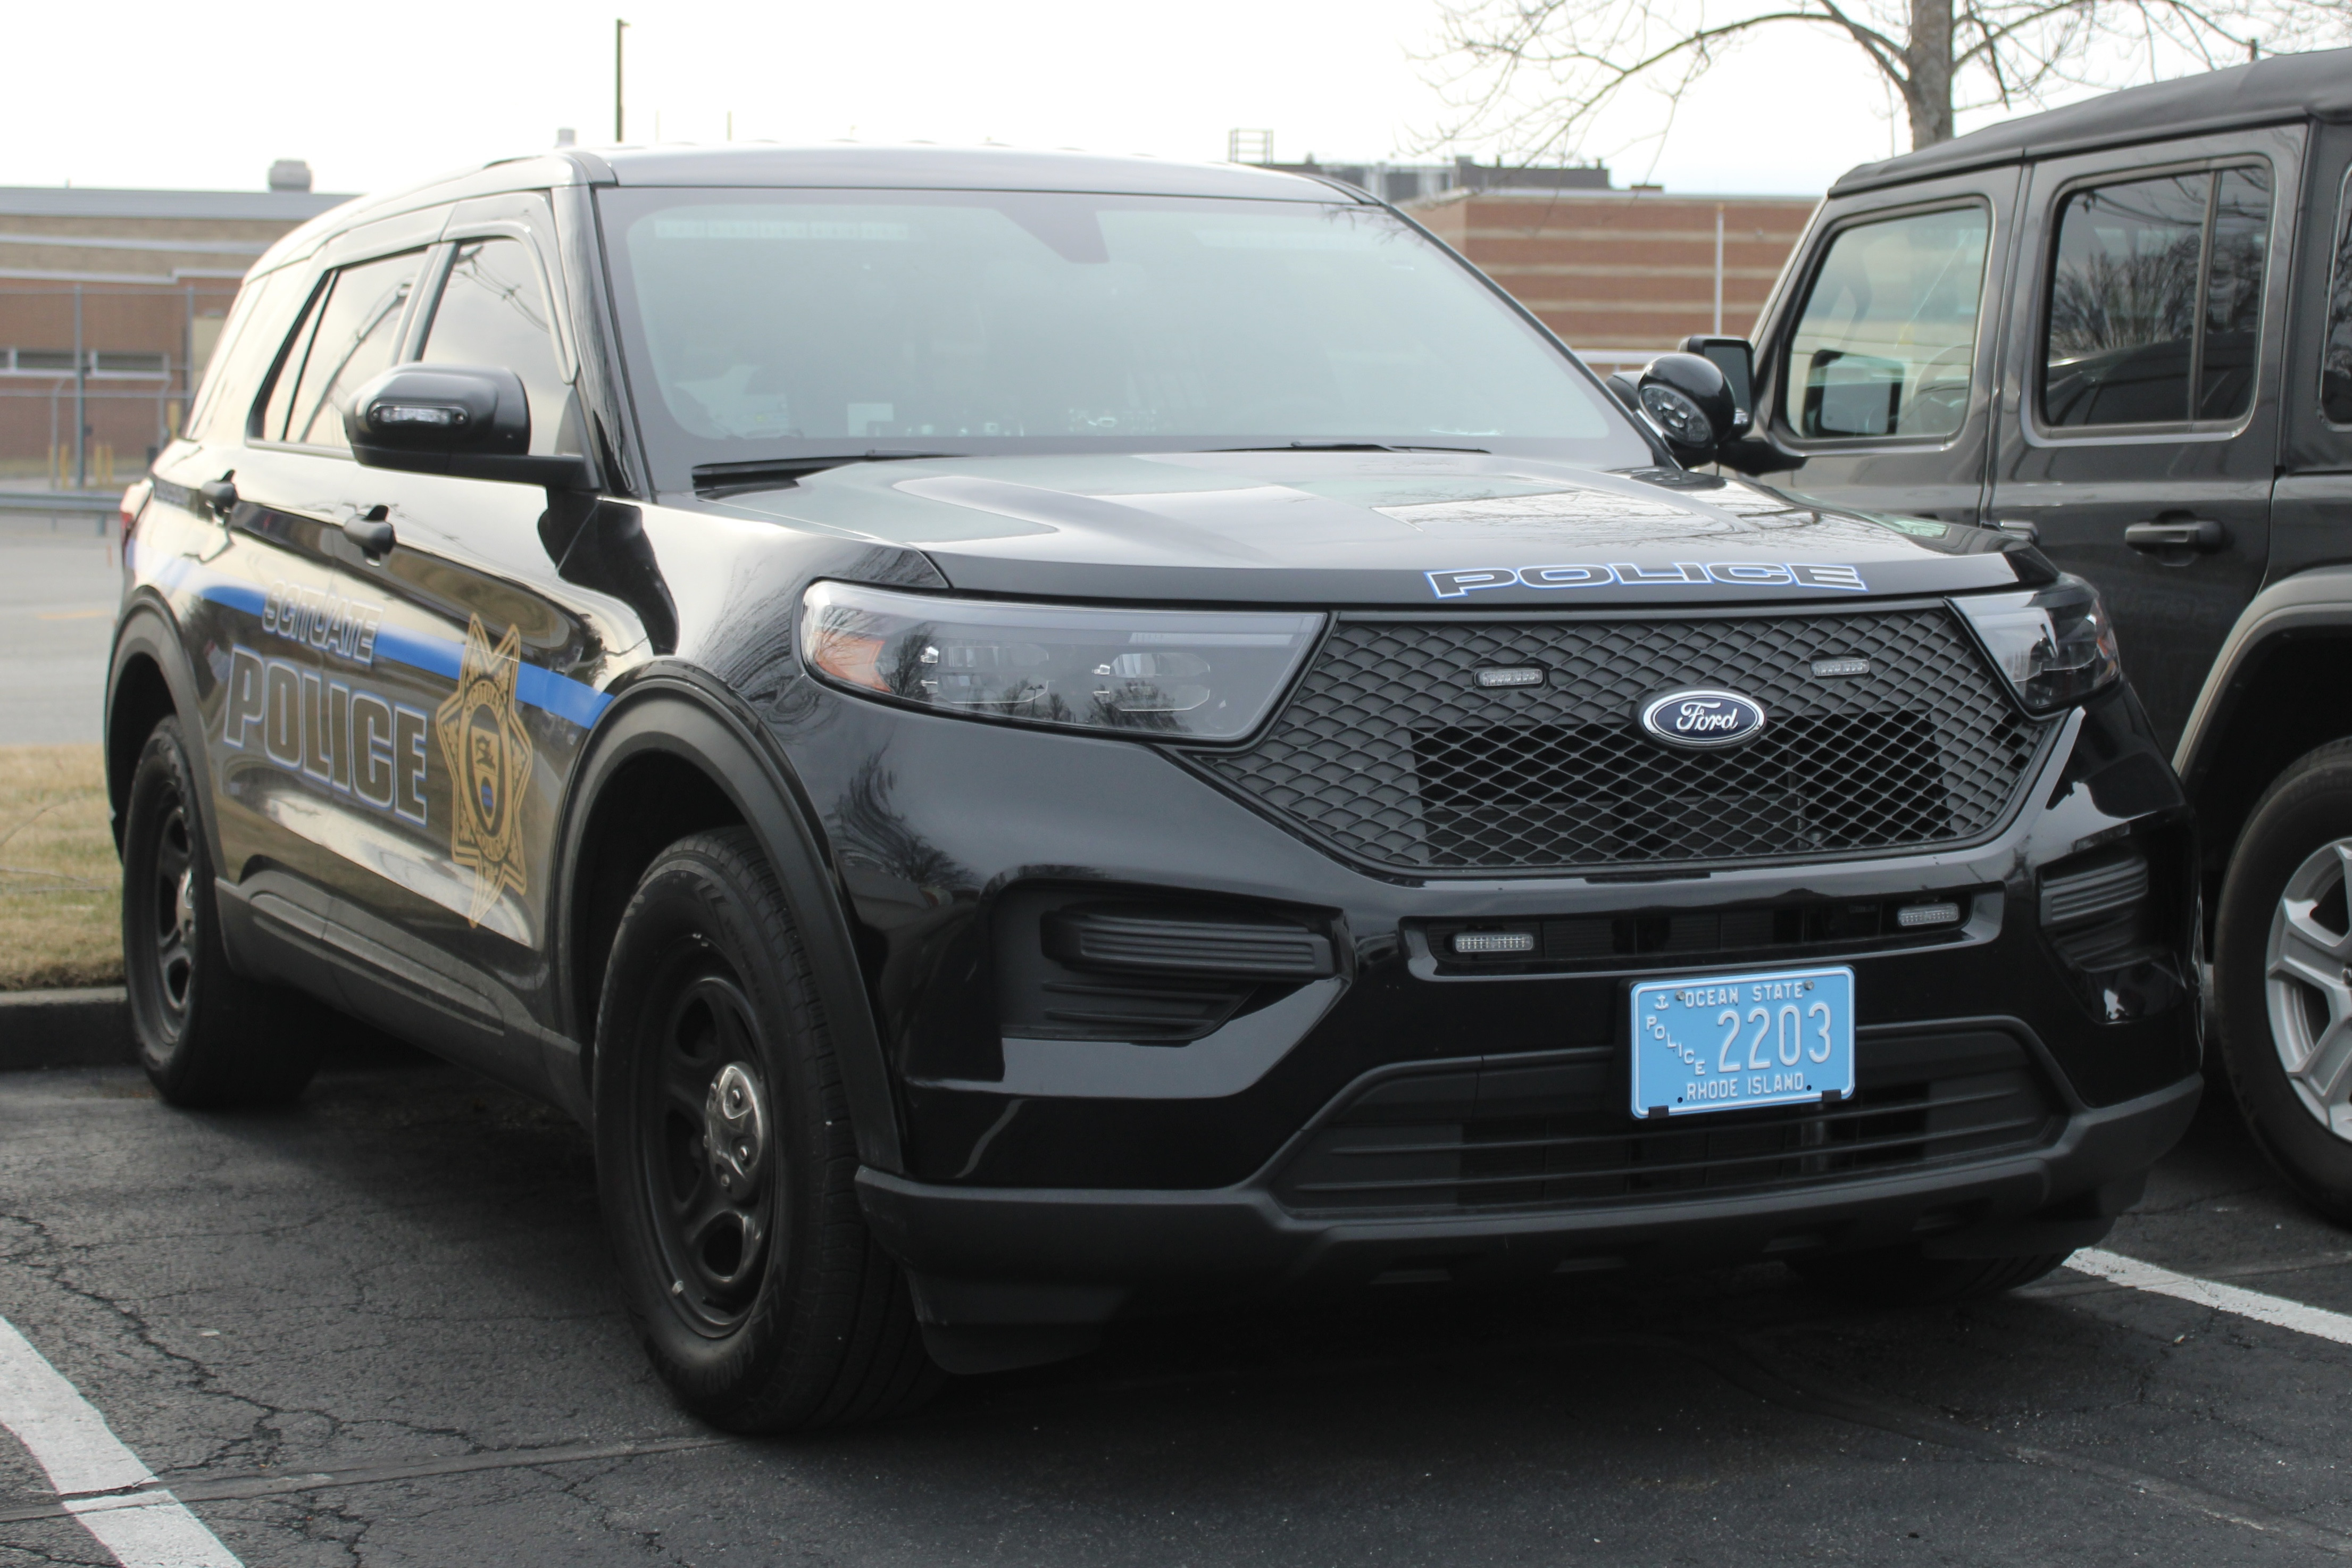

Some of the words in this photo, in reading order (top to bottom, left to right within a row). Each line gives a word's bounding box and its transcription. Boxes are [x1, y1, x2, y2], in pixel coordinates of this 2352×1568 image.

[1424, 562, 1869, 599] POLICE
[262, 578, 384, 665] SCITUATE
[223, 643, 427, 826] POLICE
[1677, 701, 1738, 731] Ford
[1684, 987, 1739, 1008] OCEAN
[1752, 982, 1804, 1002] STATE
[1646, 1015, 1706, 1076] POLICE
[1717, 1003, 1831, 1073] 2203
[1686, 1079, 1738, 1101] RHODE
[1747, 1072, 1804, 1096] ISLAND
